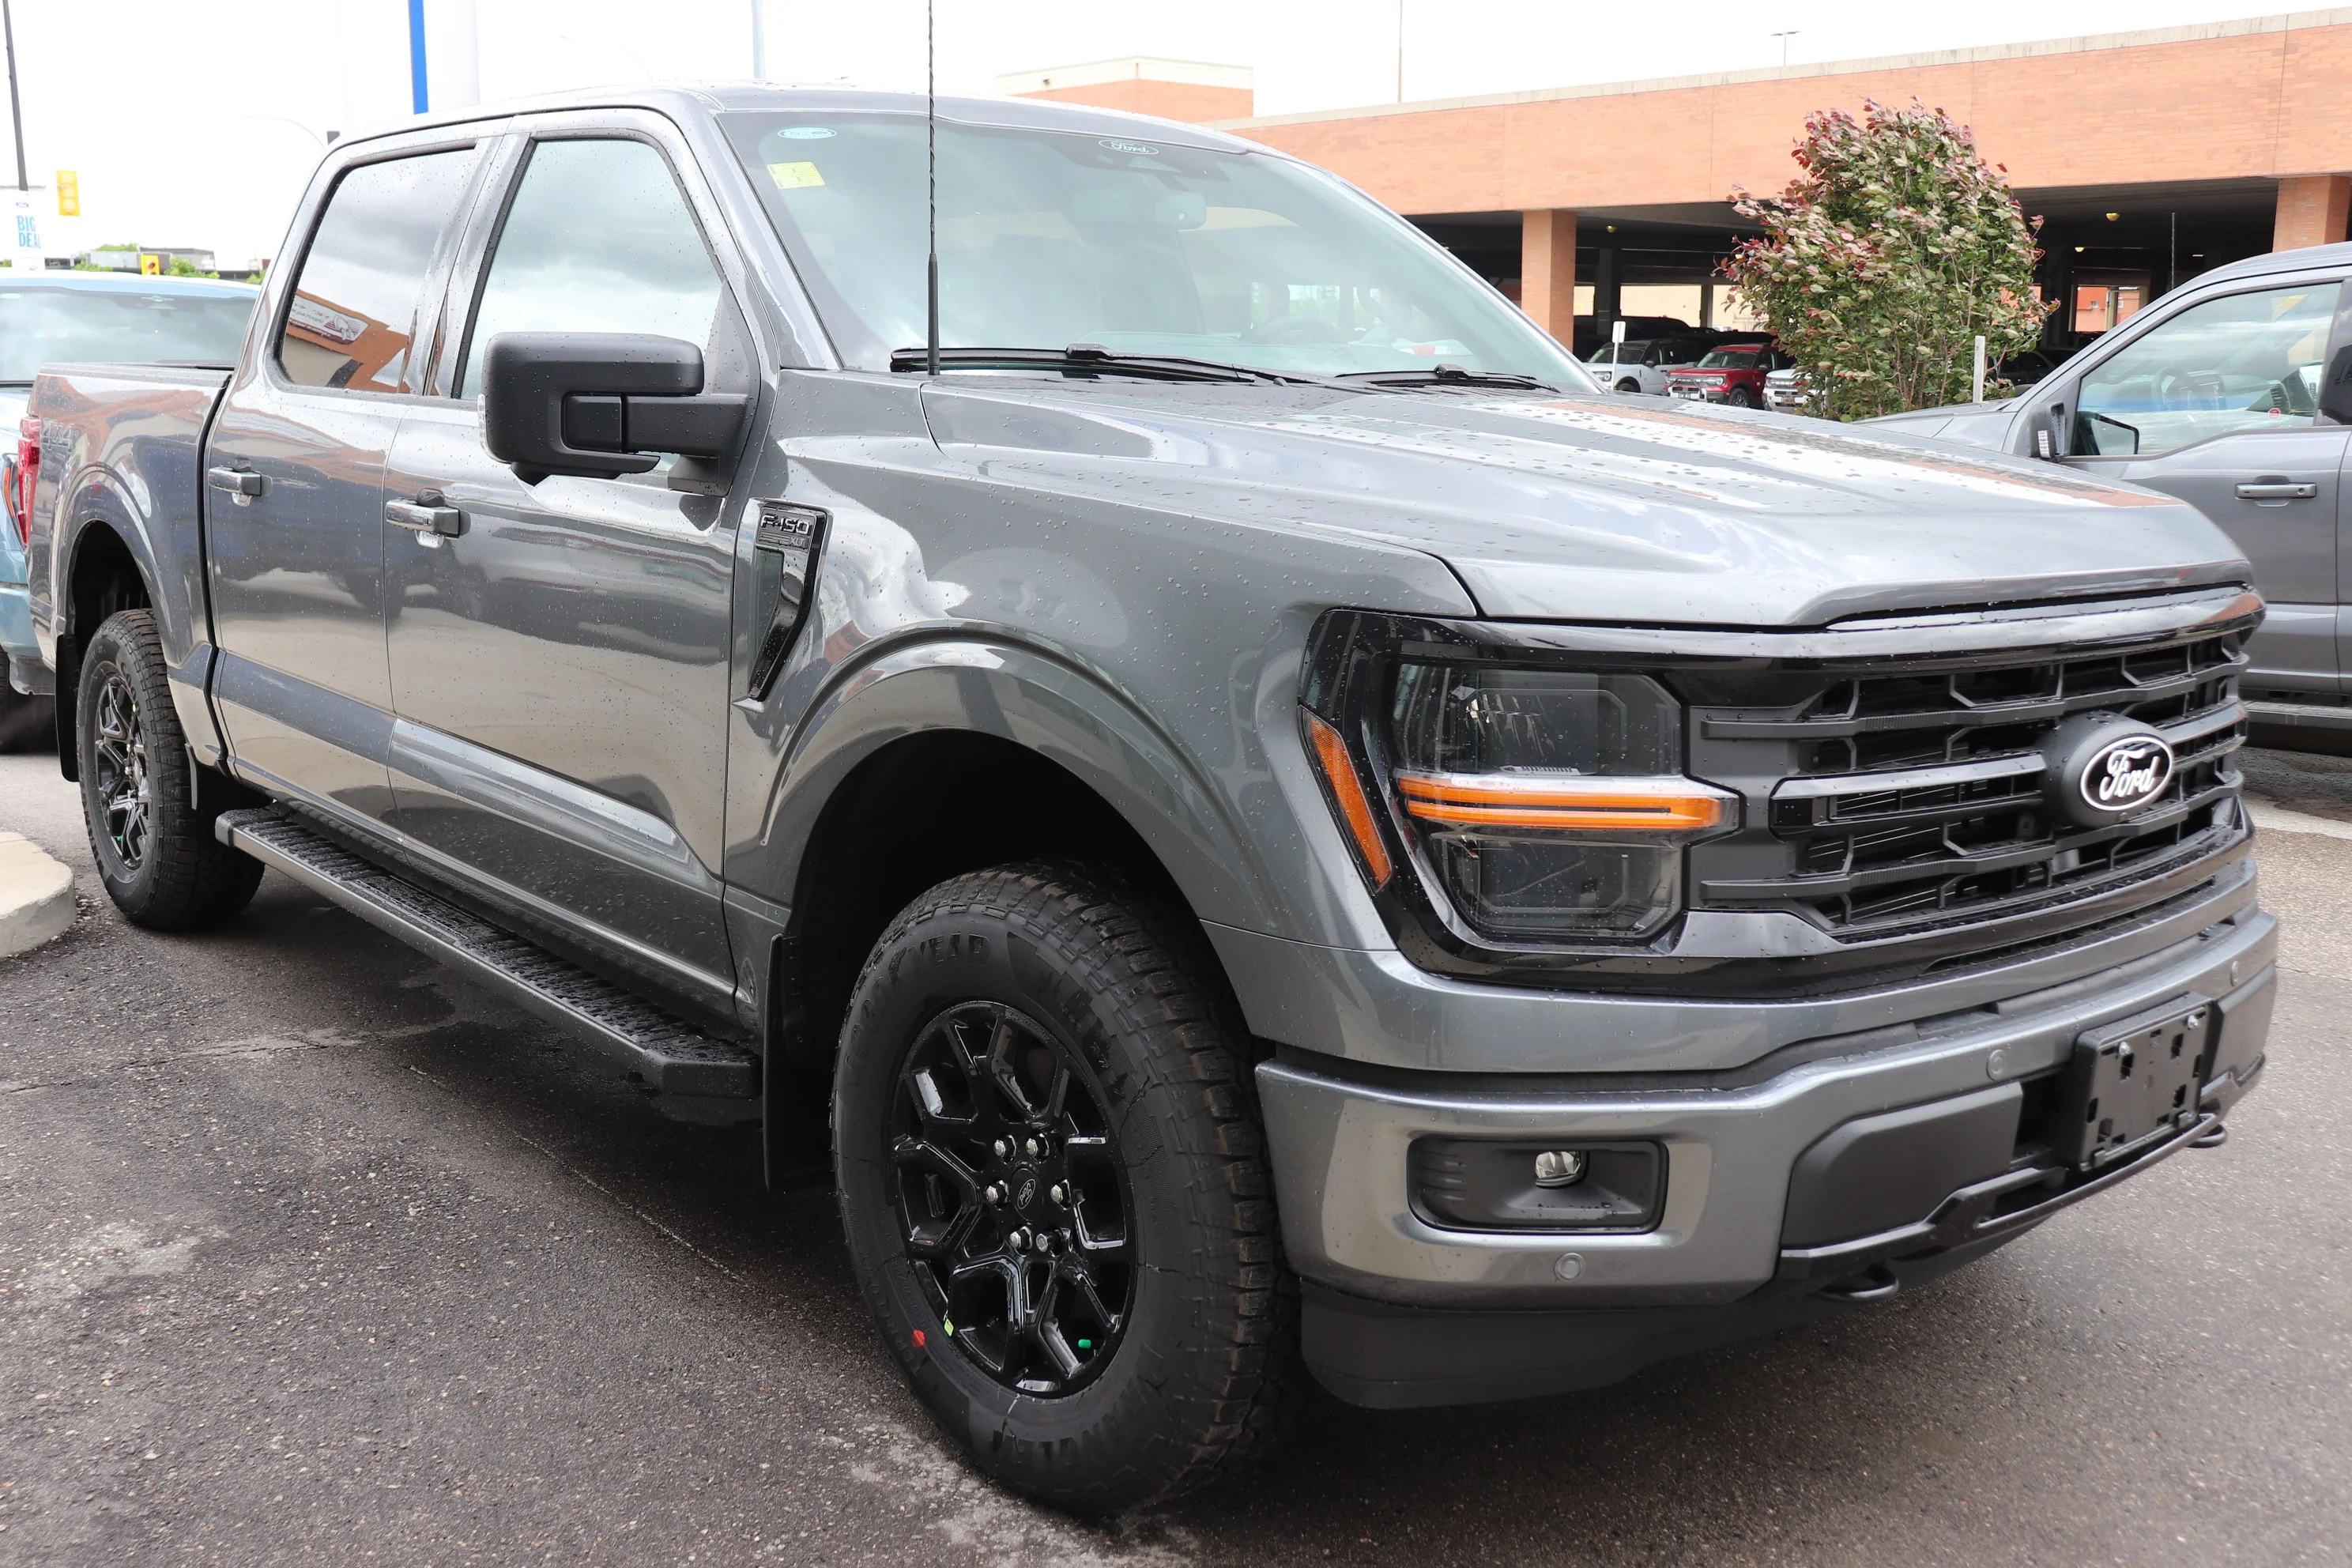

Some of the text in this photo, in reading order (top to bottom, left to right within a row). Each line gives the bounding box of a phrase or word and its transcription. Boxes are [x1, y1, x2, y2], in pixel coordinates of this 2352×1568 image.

[17, 215, 36, 232] BIG
[18, 232, 41, 249] DEAL
[760, 512, 811, 535] F-150
[789, 537, 805, 548] XLT
[2099, 748, 2161, 801] Ford
